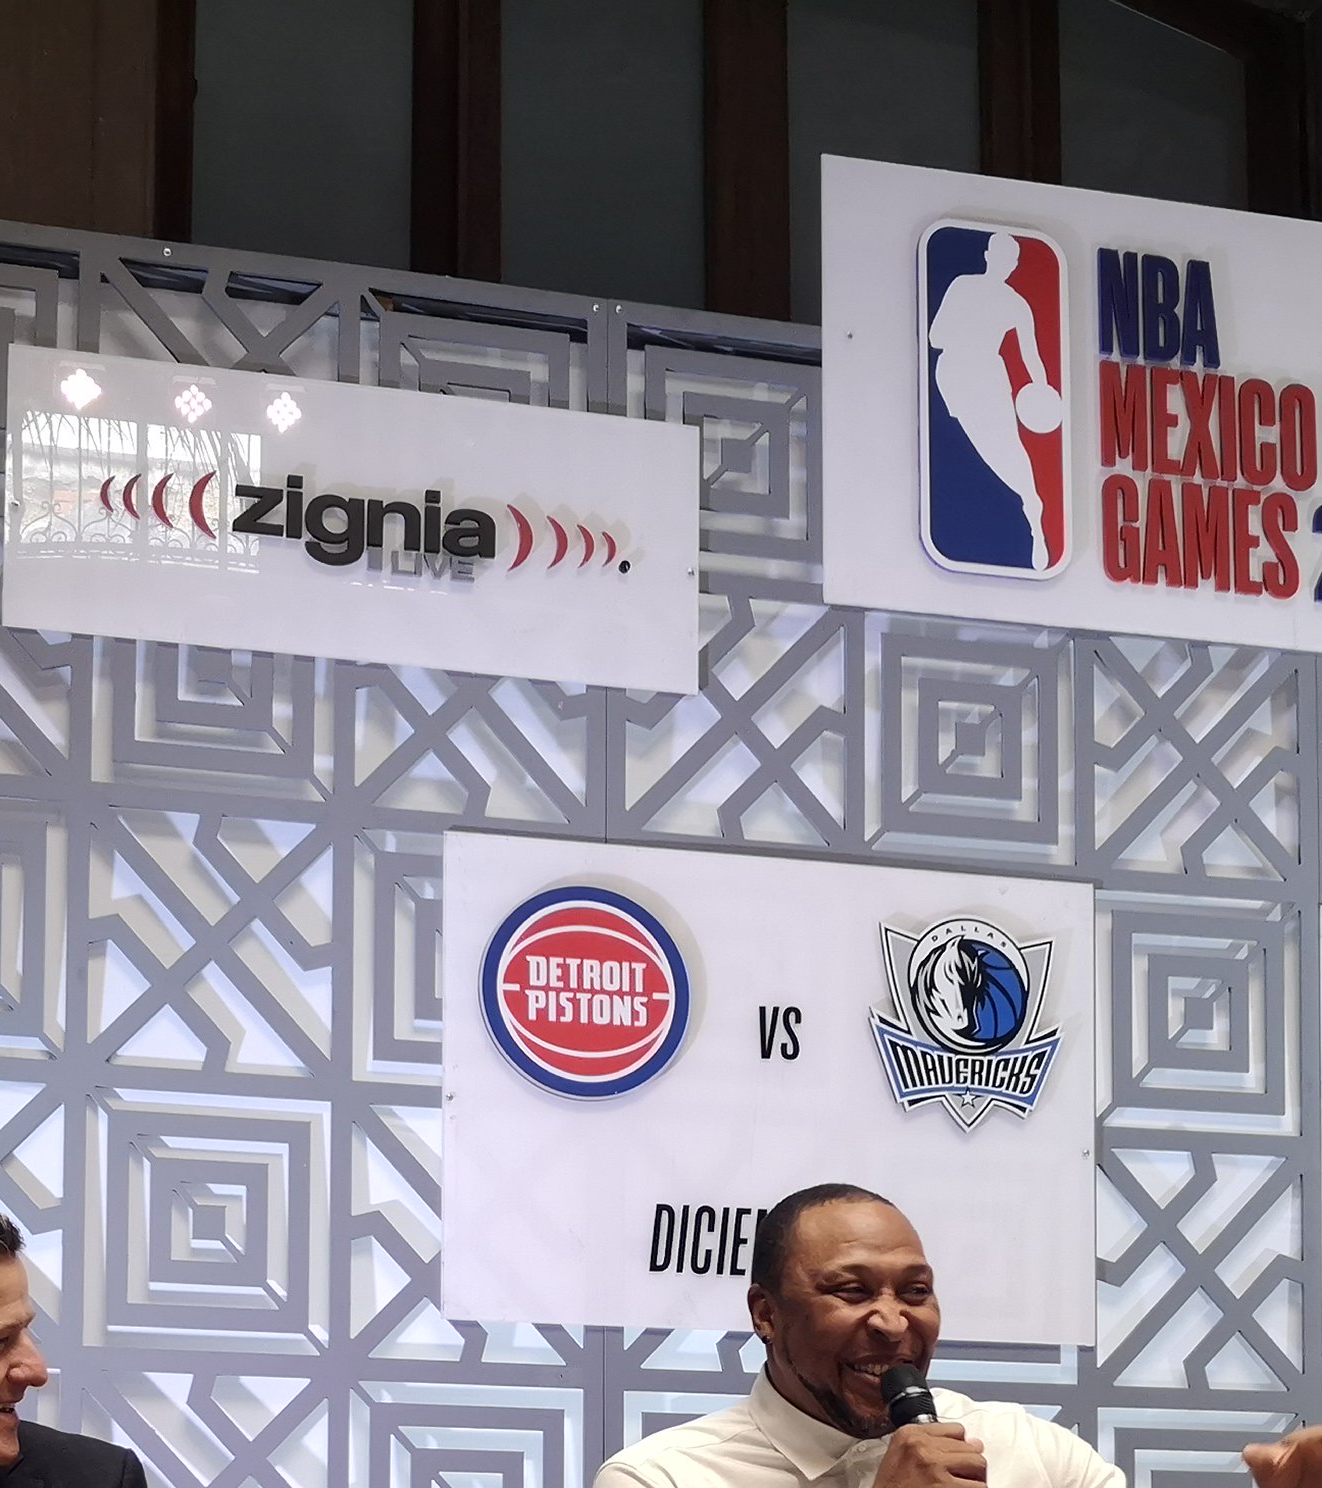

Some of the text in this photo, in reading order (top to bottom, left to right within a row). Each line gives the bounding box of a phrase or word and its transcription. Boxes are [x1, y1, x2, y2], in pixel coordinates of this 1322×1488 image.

[1097, 248, 1220, 369] NBA
[1099, 360, 1318, 491] MEXICO
[232, 474, 496, 566] zignia
[1101, 474, 1300, 600] GAMES
[931, 925, 1007, 948] DALLAS
[526, 955, 647, 992] DETROIT
[525, 990, 648, 1027] PISTONS
[759, 1006, 802, 1060] VS
[887, 1037, 1047, 1095] MAVERICKS
[649, 1204, 768, 1276] DICIE
